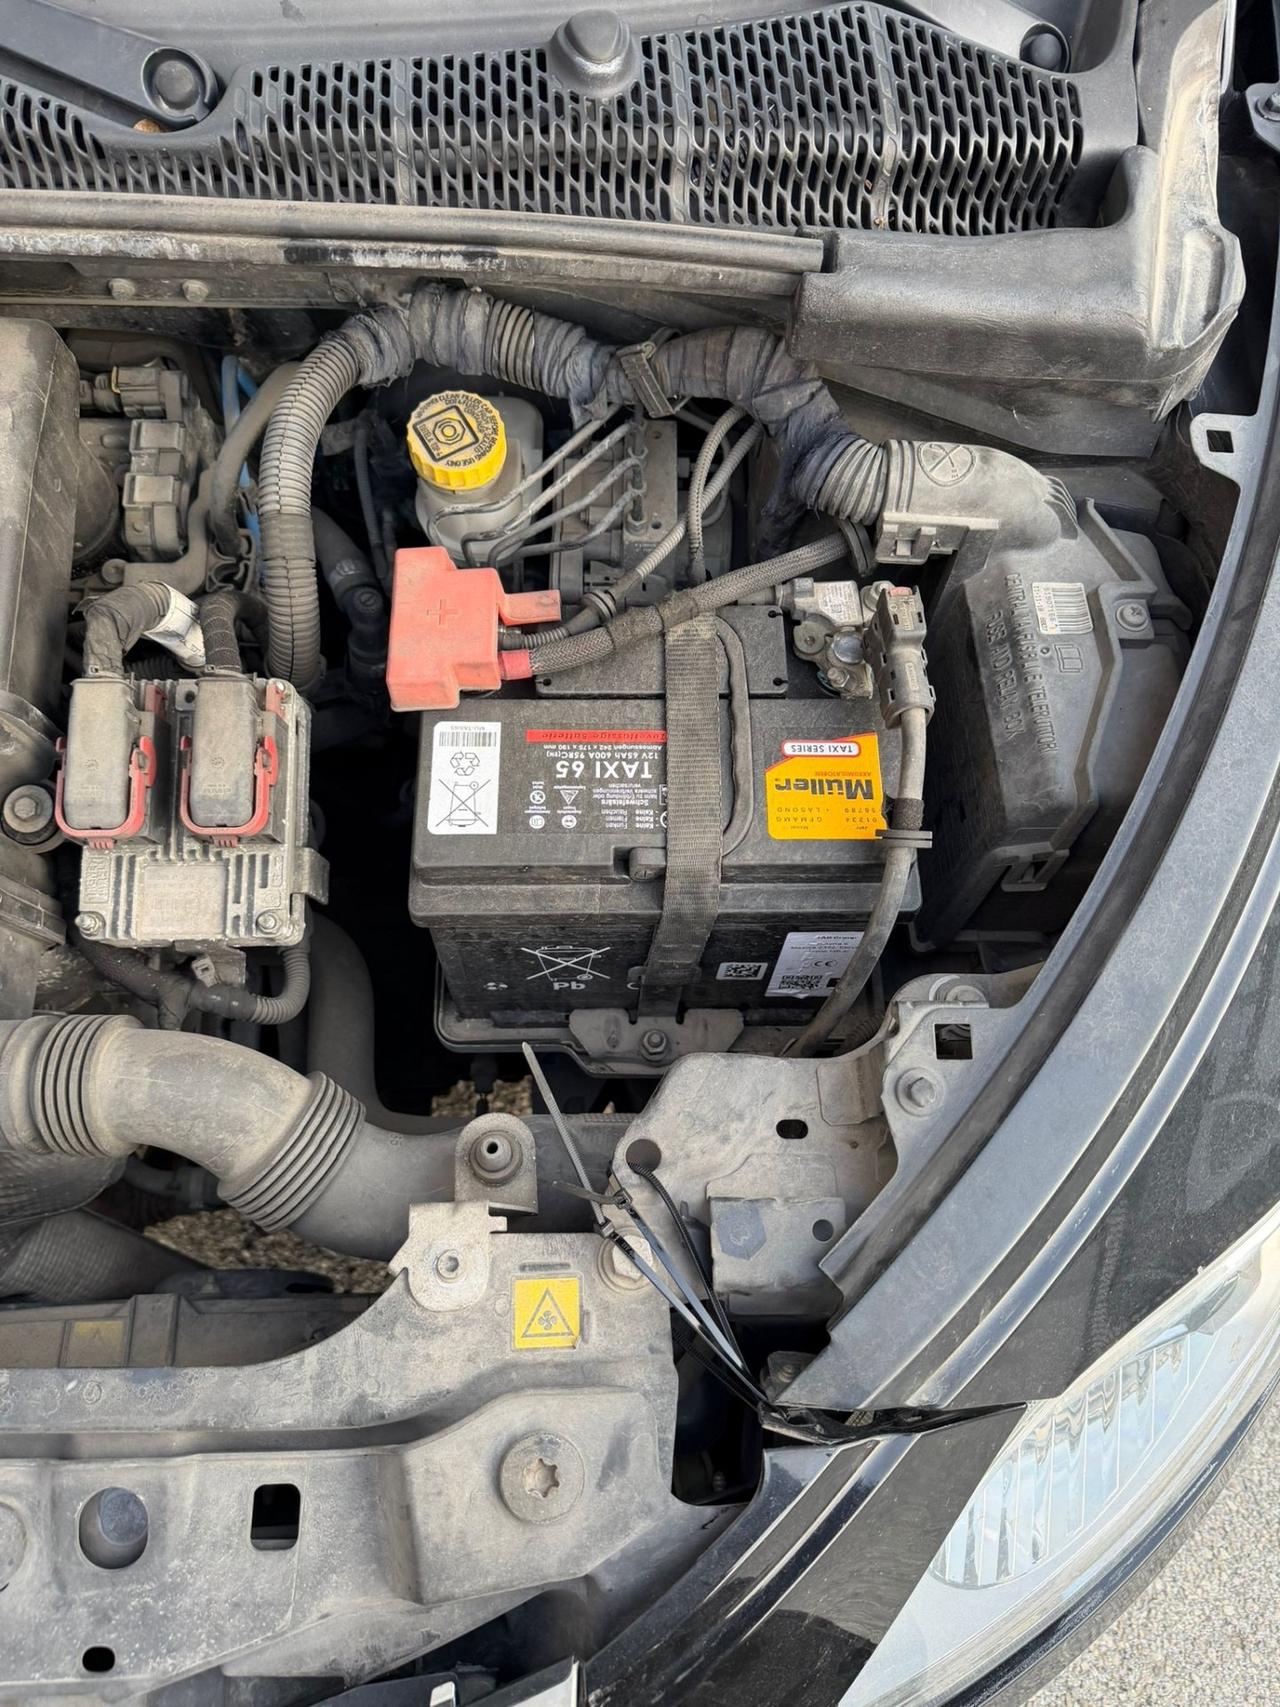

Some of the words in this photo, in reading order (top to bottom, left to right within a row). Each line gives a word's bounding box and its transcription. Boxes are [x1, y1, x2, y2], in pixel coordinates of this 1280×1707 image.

[791, 744, 824, 753] SERIES
[828, 744, 853, 753] TAXI
[556, 760, 584, 778] 65
[595, 761, 652, 778] TAXI
[774, 778, 874, 800] Müller
[552, 981, 586, 990] Pb
